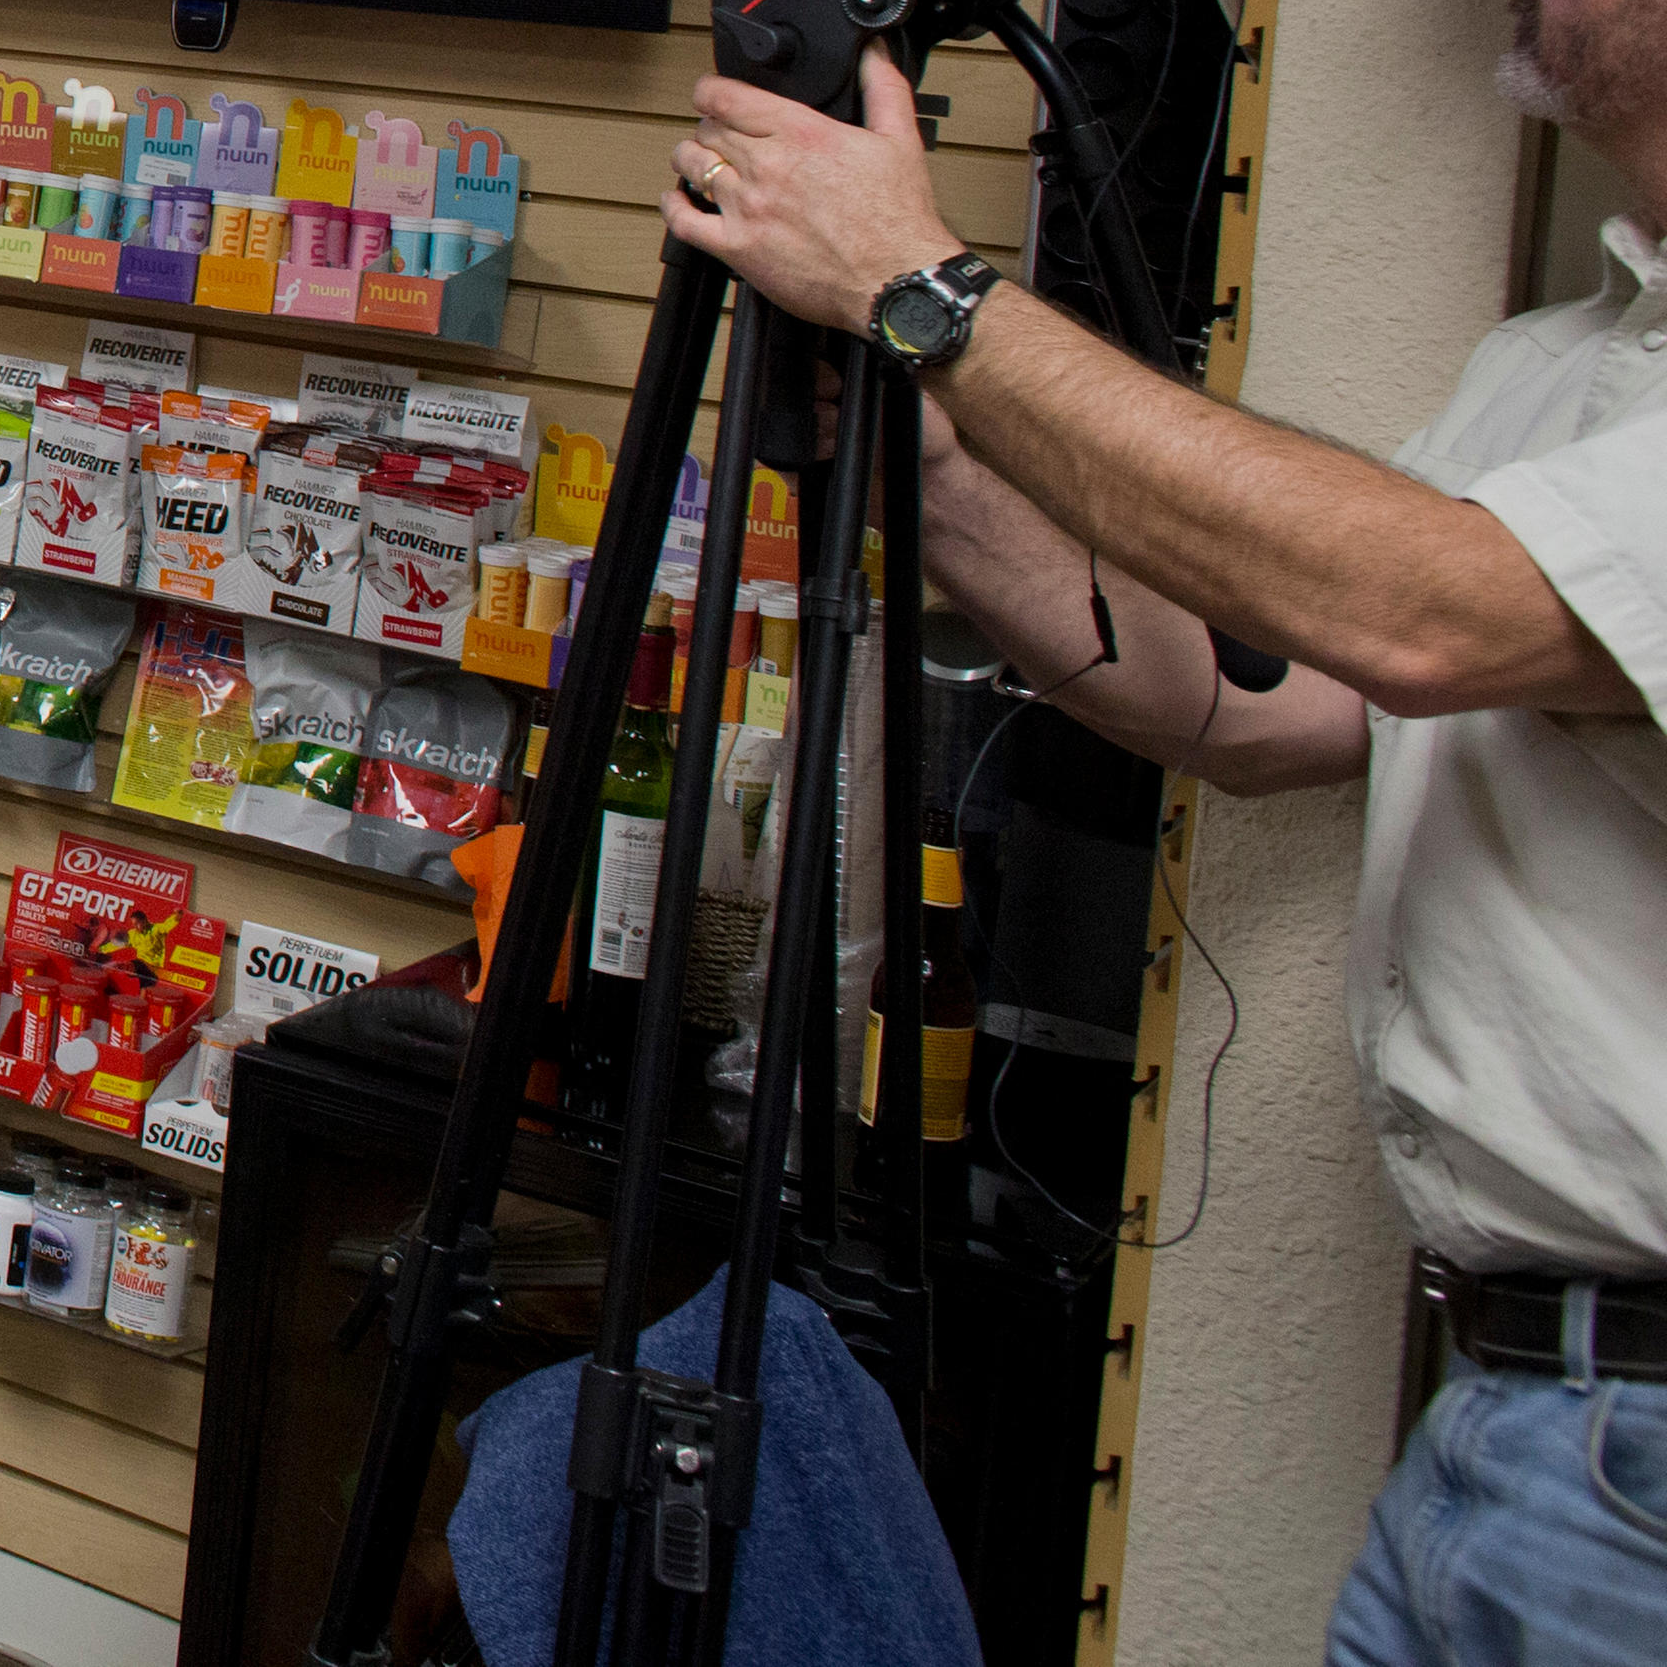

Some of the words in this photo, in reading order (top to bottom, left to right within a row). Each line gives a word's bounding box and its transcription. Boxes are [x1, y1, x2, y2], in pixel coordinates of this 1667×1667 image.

[0, 124, 47, 141] nuun
[70, 129, 119, 149] nuun
[143, 139, 193, 157] nuun
[216, 147, 268, 165] nuun
[298, 152, 350, 174] nuun
[455, 176, 511, 195] nuun
[52, 245, 107, 267] nuun
[308, 282, 351, 299] nuun
[368, 283, 428, 306] nuun
[89, 338, 187, 366] RECOVERITE
[304, 373, 410, 404] RECOVERITE
[410, 399, 521, 433] RECOVERITE
[294, 479, 337, 496] HAMMER
[263, 484, 361, 522] RECOVERITE
[156, 496, 229, 535] HEED
[284, 510, 332, 531] CHOCOLATE
[396, 518, 437, 537] HAMMER
[370, 521, 468, 563] RECOVERITE
[43, 548, 95, 569] STRAWBERRY
[386, 548, 442, 571] STRAWBERRY
[276, 597, 324, 619] CHOCOLATE
[384, 620, 442, 642] STRAWBERRY
[473, 630, 537, 659] nuun
[0, 641, 93, 684] kratch
[258, 710, 366, 747] skratch
[378, 728, 501, 780] skratch
[97, 859, 185, 896] ENERVIT
[19, 872, 54, 901] GT
[51, 881, 136, 924] SPORT
[279, 936, 345, 964] PERPETUEM
[145, 1122, 225, 1165] SOLIDS
[112, 1268, 167, 1298] ENDURANCE
